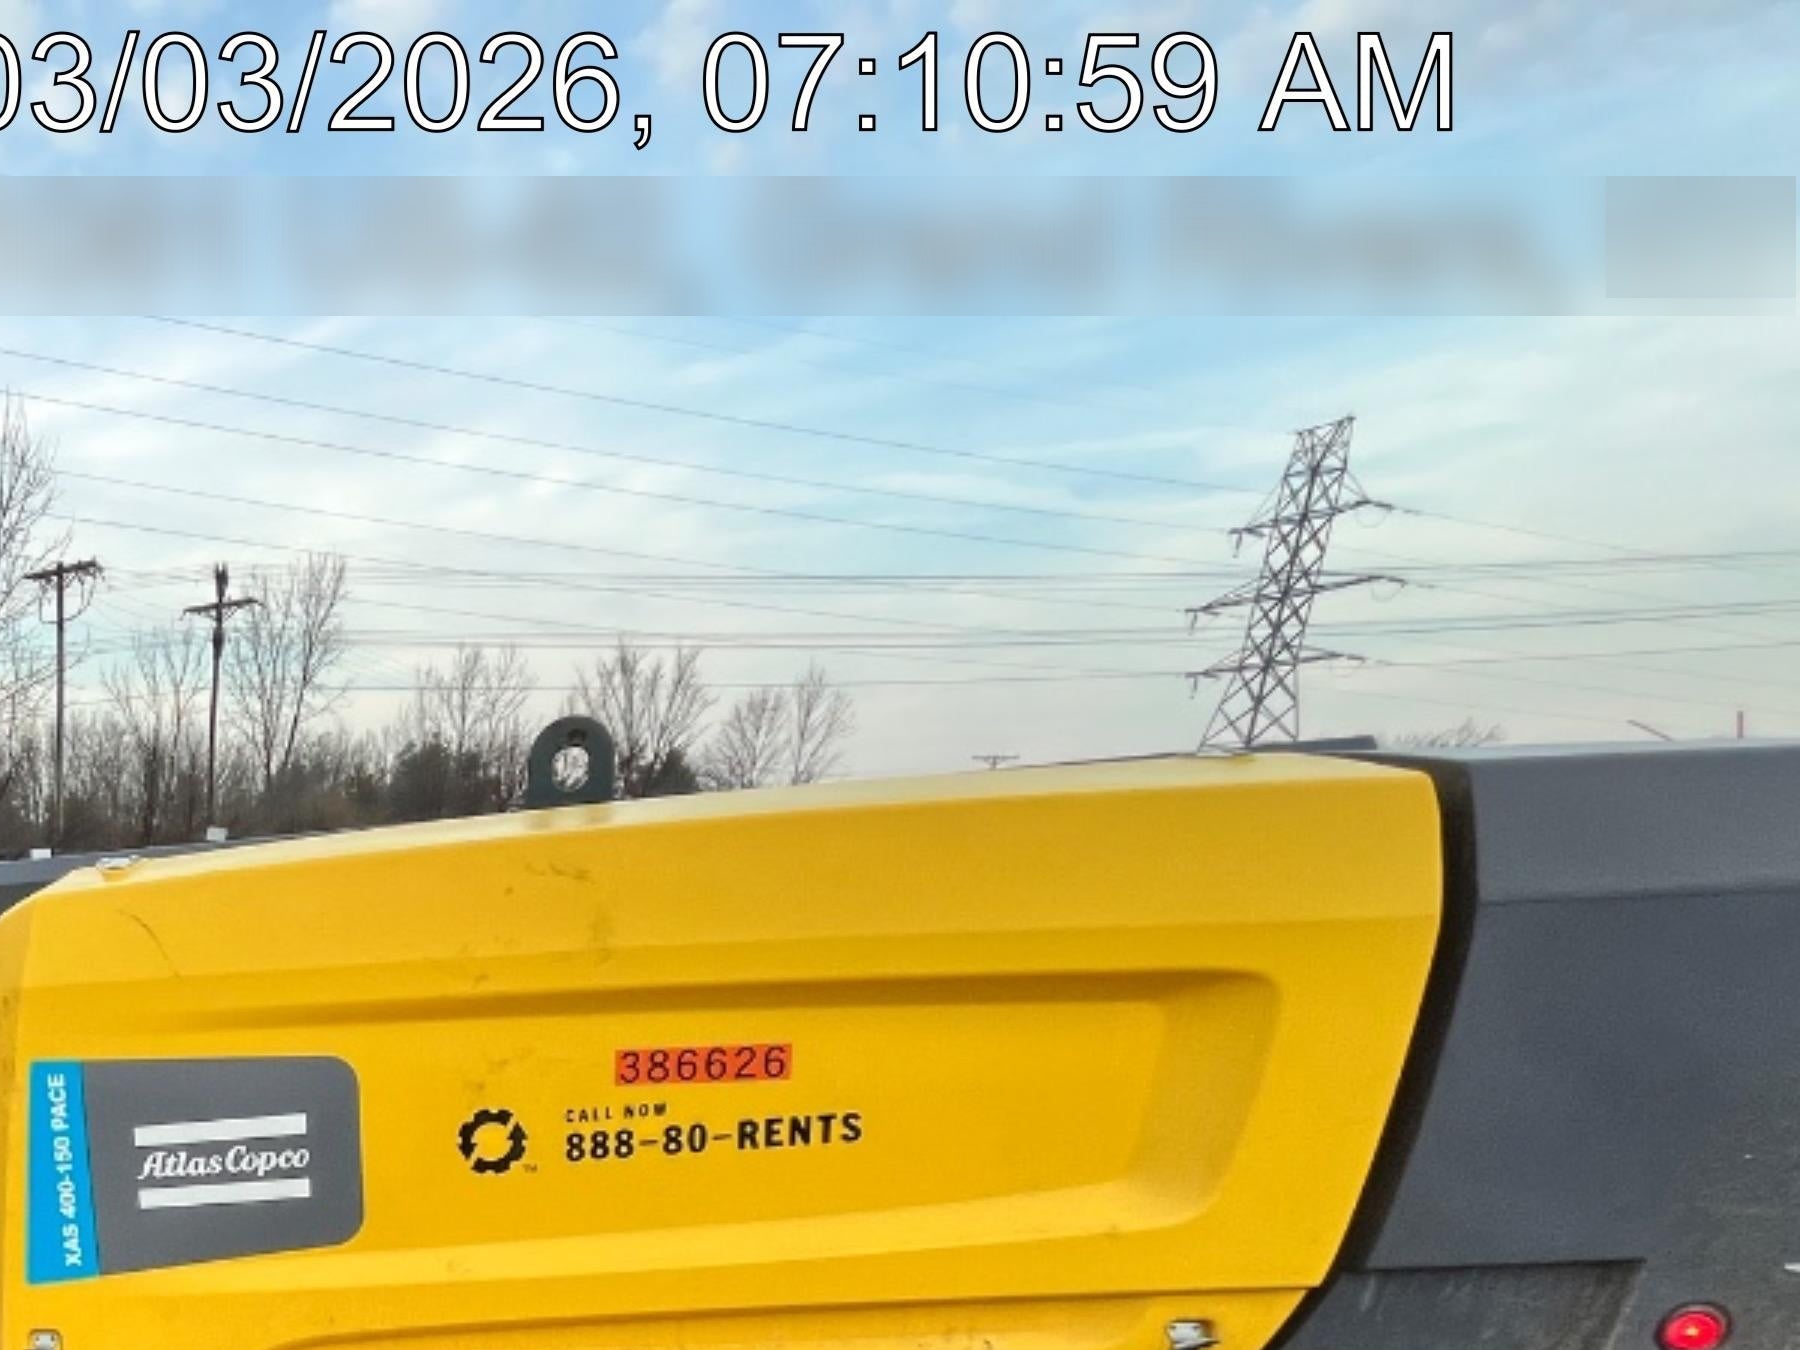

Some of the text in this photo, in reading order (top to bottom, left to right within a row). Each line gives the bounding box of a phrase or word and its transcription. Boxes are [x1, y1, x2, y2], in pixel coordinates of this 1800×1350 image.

[620, 1046, 786, 1083] 386626
[565, 1103, 667, 1122] CALL NOW
[565, 1112, 863, 1162] 888-80-RENTS
[48, 1073, 82, 1266] XAS 400-150 PACE
[137, 1145, 310, 1180] Atlas Copco
